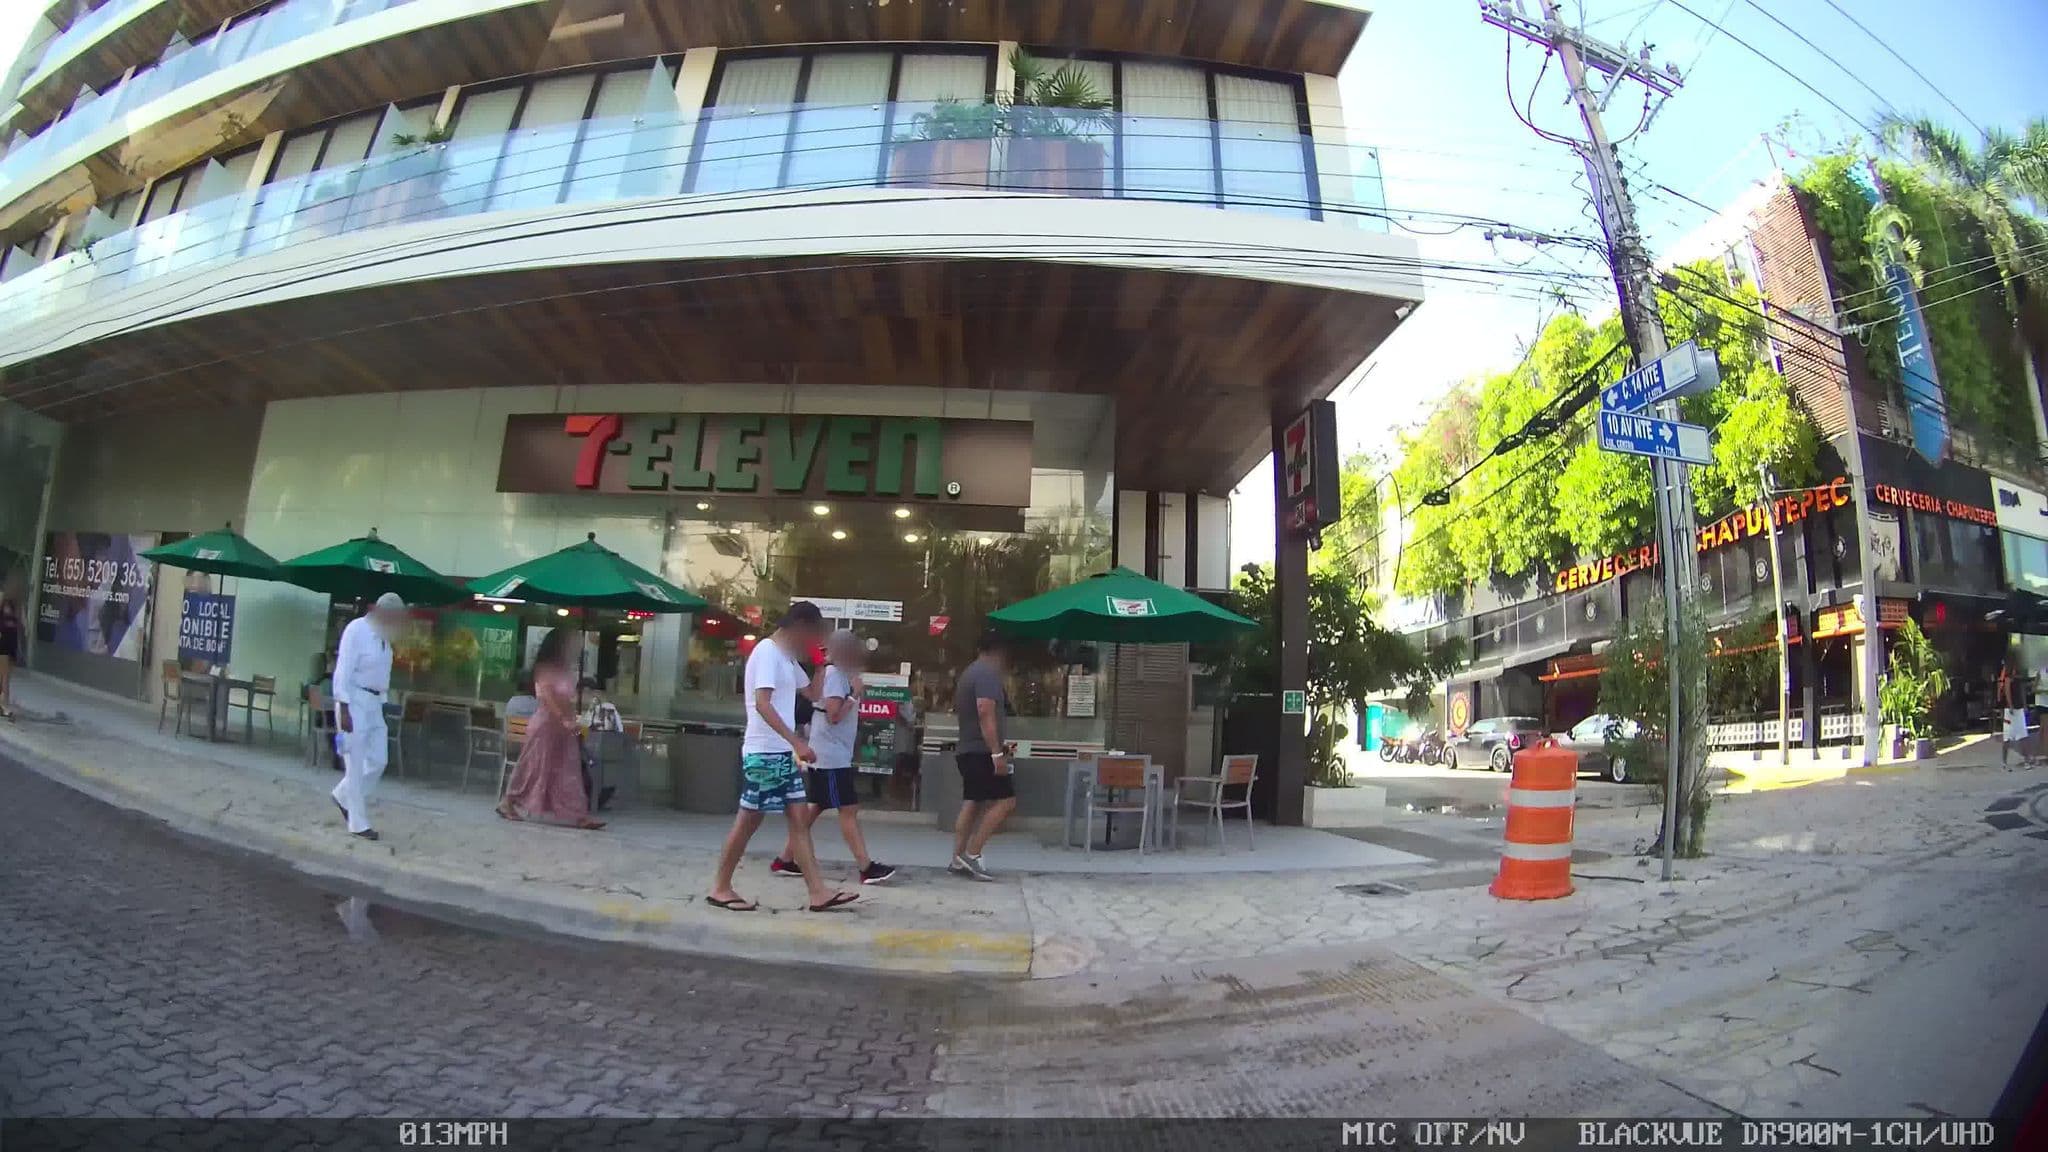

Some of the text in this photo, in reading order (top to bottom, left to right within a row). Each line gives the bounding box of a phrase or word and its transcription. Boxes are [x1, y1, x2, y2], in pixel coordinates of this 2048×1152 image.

[1632, 373, 1642, 395] 14
[1642, 363, 1660, 389] NTE
[1607, 414, 1654, 440] 10 AV NTE
[1875, 483, 1942, 513] CERVECERIA
[45, 557, 59, 579] Tel.
[63, 558, 85, 580] (55)
[87, 560, 118, 585] 5209
[1555, 543, 1659, 594] CERVECERI
[199, 601, 231, 619] LOCAL
[181, 617, 230, 638] ONIBLE
[866, 690, 904, 699] Welcome
[859, 703, 890, 714] LIDA
